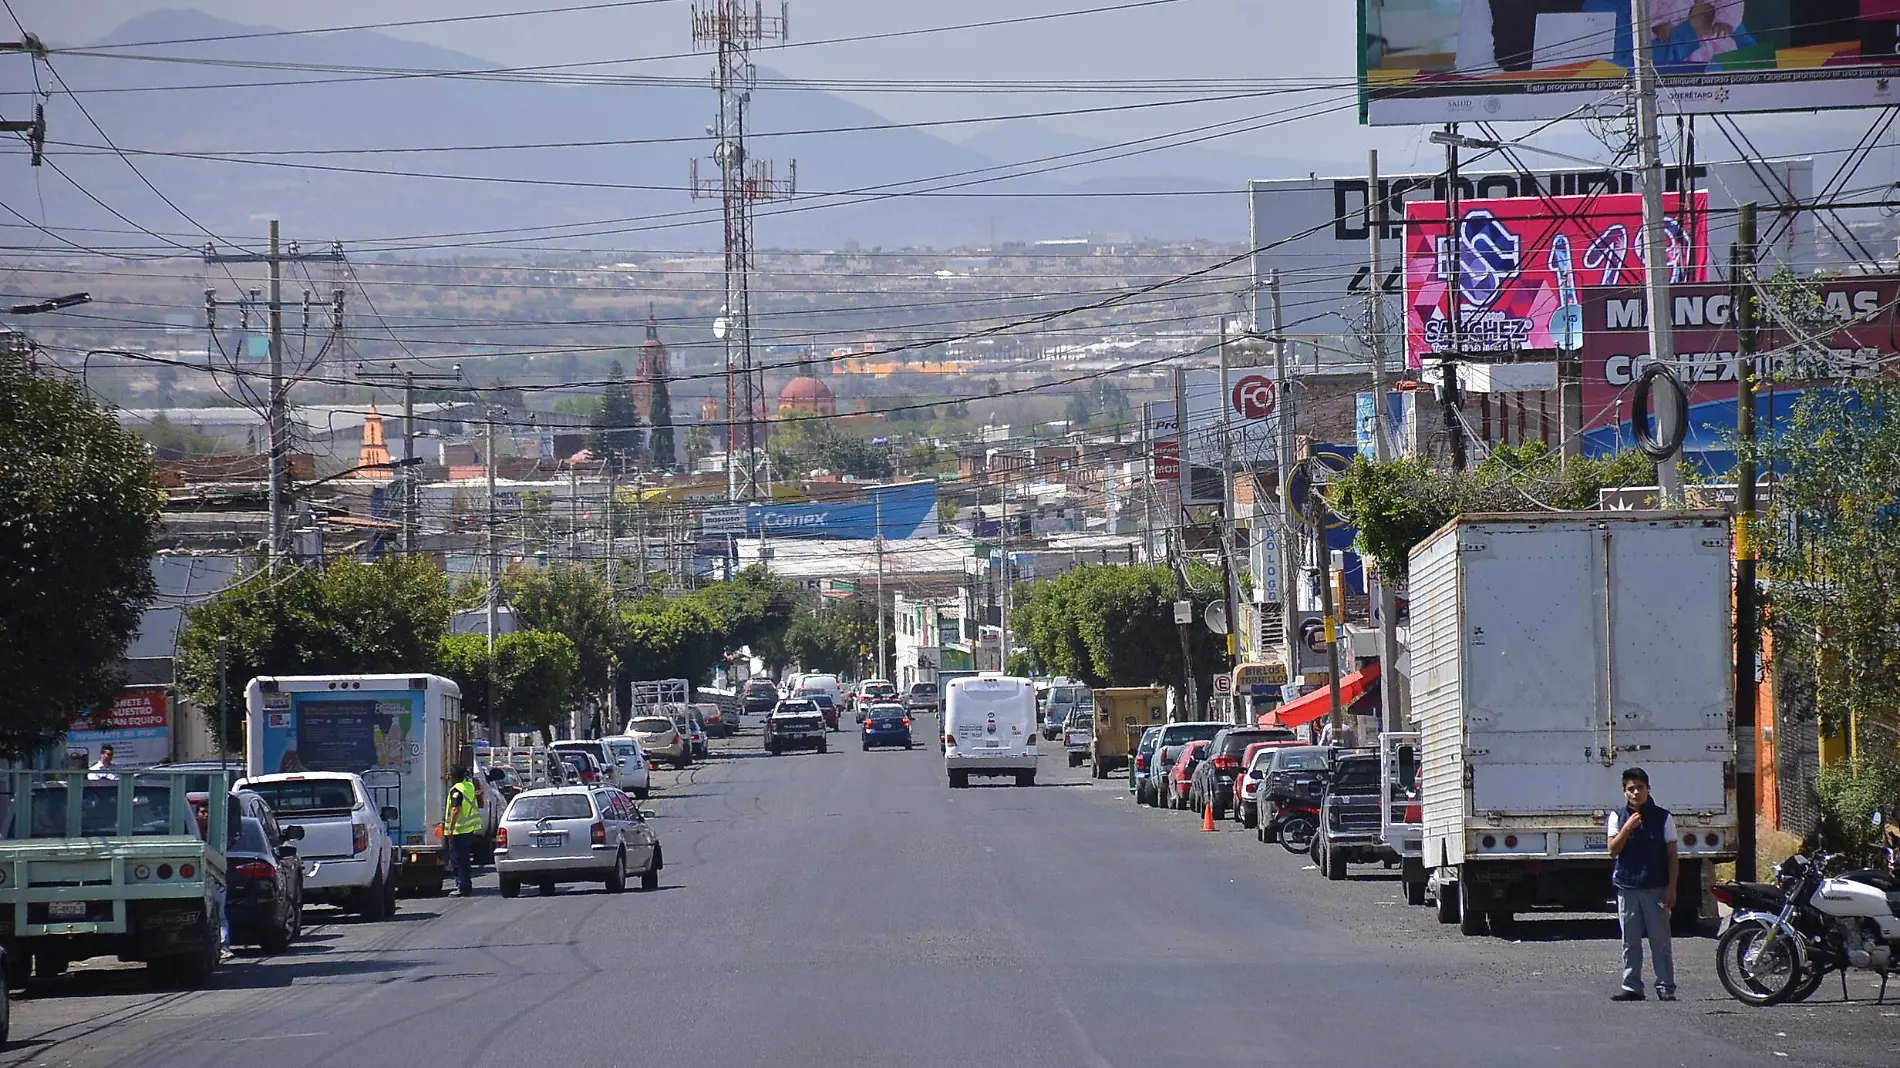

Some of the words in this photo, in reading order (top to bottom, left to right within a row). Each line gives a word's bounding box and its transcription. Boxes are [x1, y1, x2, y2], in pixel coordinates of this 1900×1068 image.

[1547, 82, 1585, 92] programa
[1245, 666, 1280, 676] BIRLOS
[143, 697, 151, 706] A
[129, 716, 163, 726] EQUIPO
